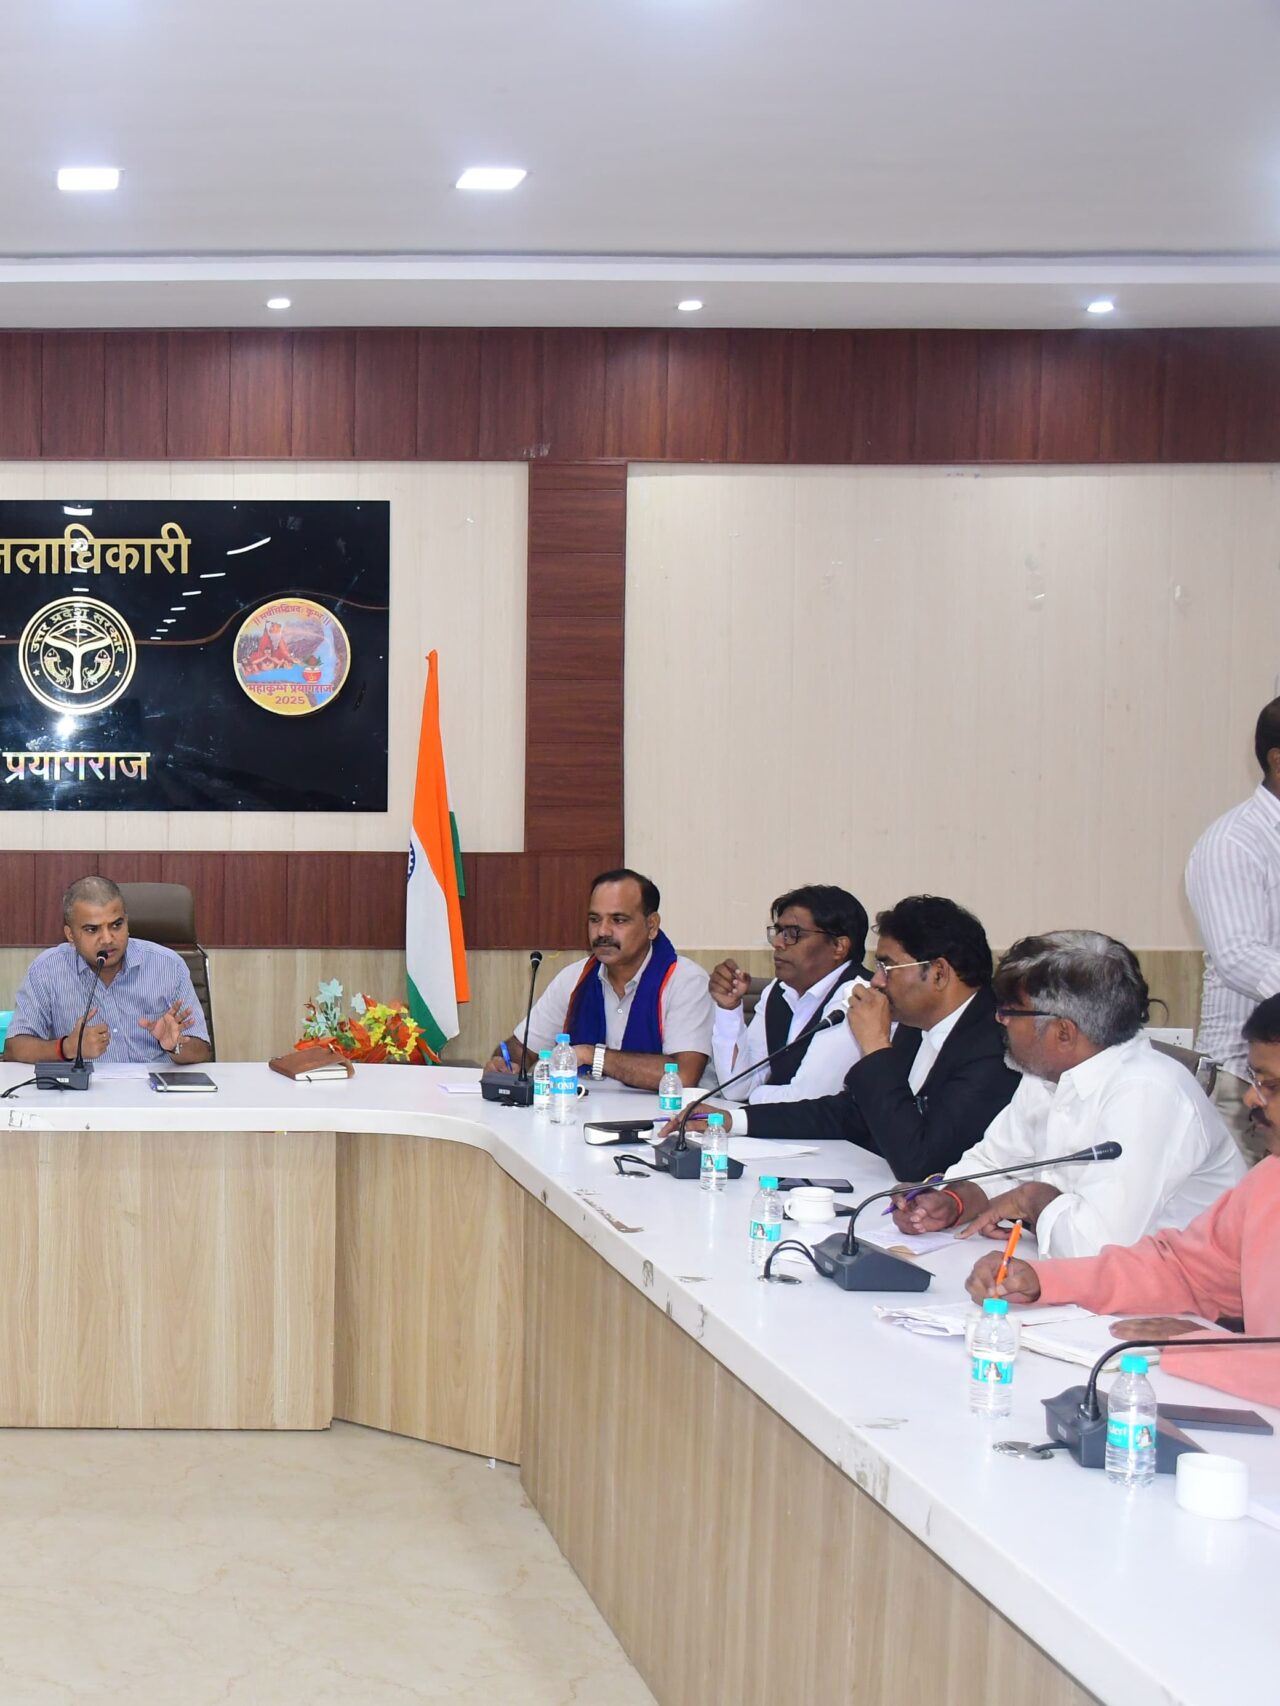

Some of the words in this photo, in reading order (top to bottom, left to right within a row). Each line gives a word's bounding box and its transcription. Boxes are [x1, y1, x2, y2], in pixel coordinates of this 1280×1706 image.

[49, 606, 90, 623] प्रदेश
[94, 612, 125, 654] सरकार
[275, 696, 305, 705] 2025
[2, 751, 151, 784] प्रयागराज
